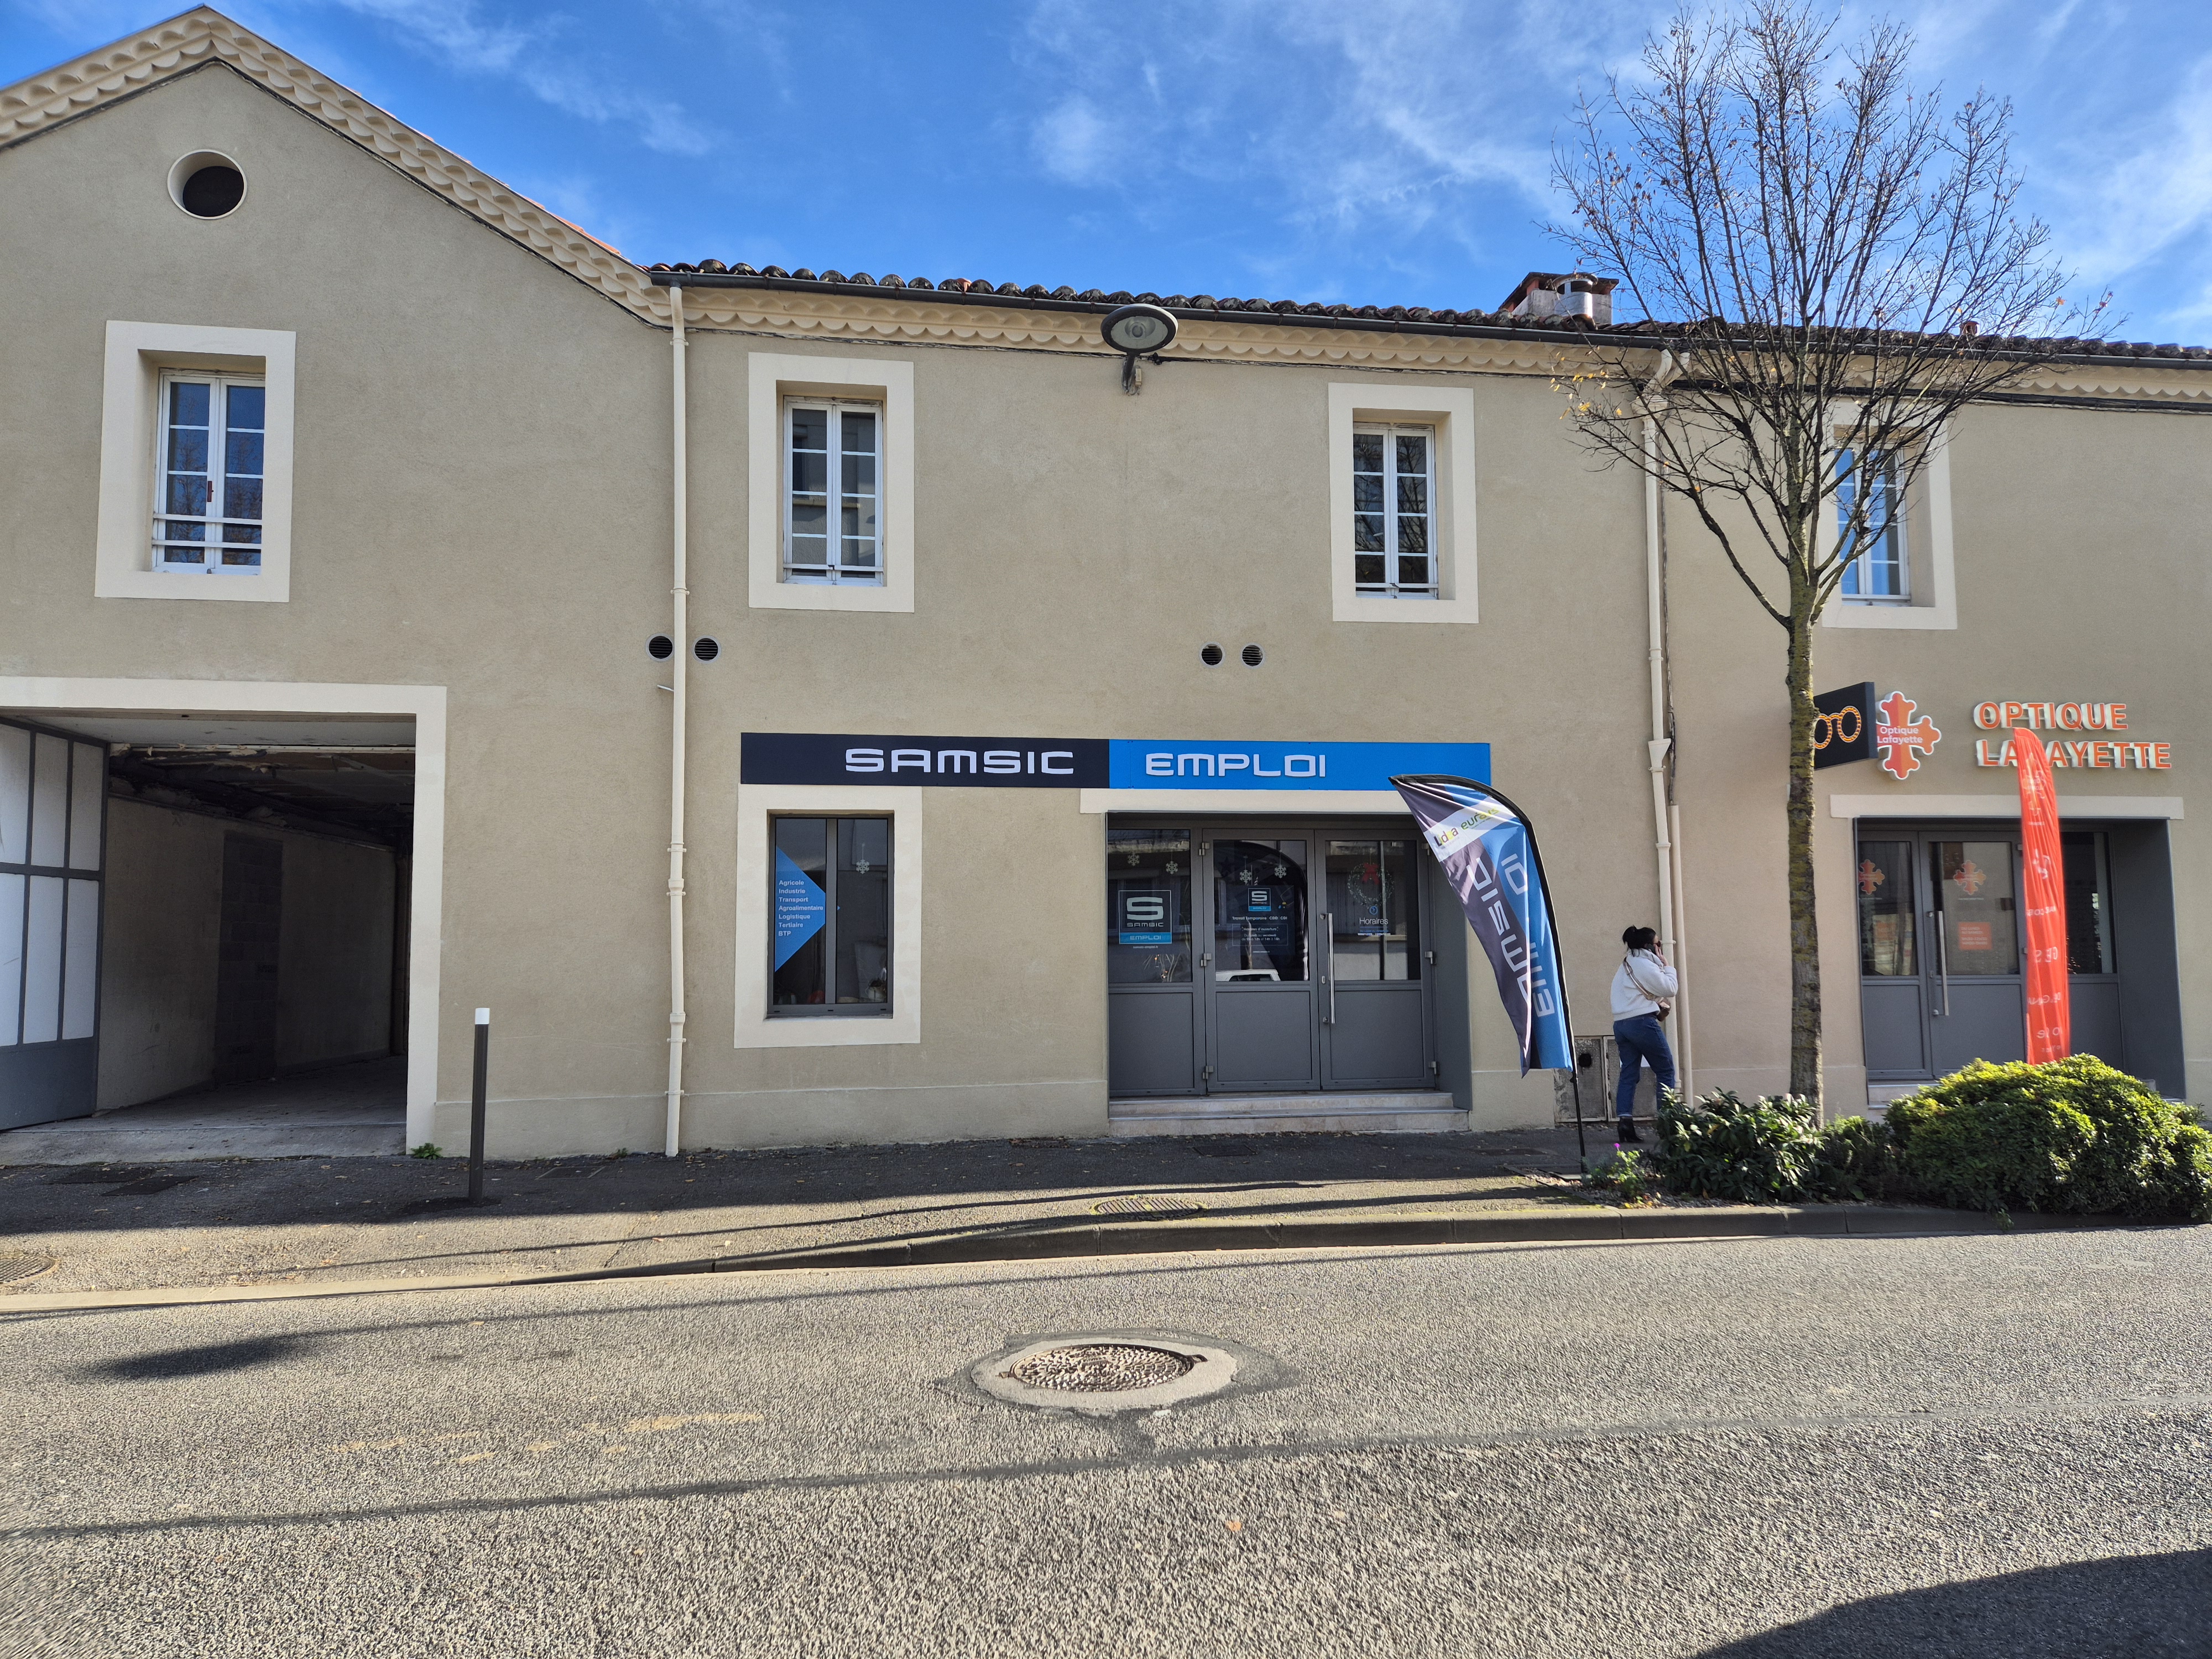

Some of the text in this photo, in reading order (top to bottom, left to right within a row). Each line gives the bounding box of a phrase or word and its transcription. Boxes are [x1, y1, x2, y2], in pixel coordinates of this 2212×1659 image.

[1880, 726, 1919, 735] Optique
[1975, 702, 2128, 731] OPTIQUE
[1877, 735, 1923, 745] Lafayette
[1976, 739, 2171, 768] LAAYETTE
[846, 748, 1326, 777] SAMSIC EMPLOI
